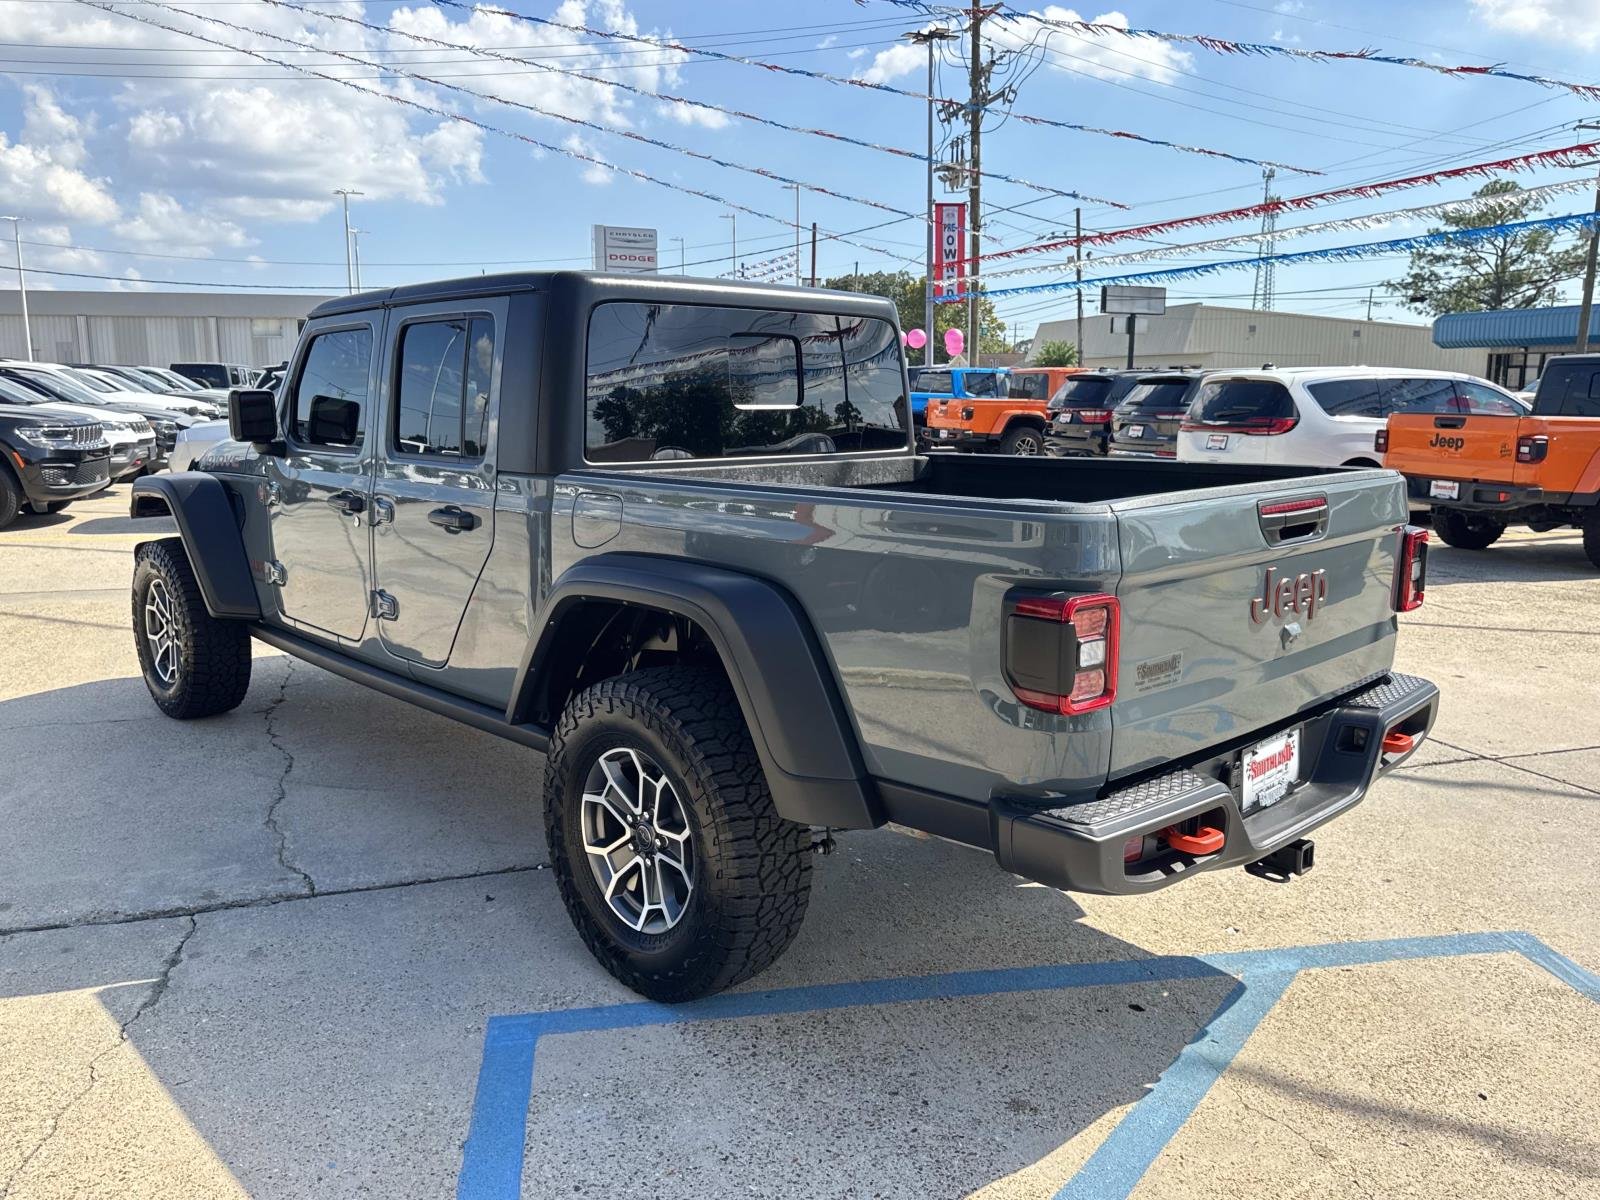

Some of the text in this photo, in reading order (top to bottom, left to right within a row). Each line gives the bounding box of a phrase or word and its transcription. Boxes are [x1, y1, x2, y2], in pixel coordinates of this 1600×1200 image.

[609, 254, 655, 262] DODGE
[1429, 433, 1465, 452] Jeep
[1250, 567, 1327, 624] Jeep
